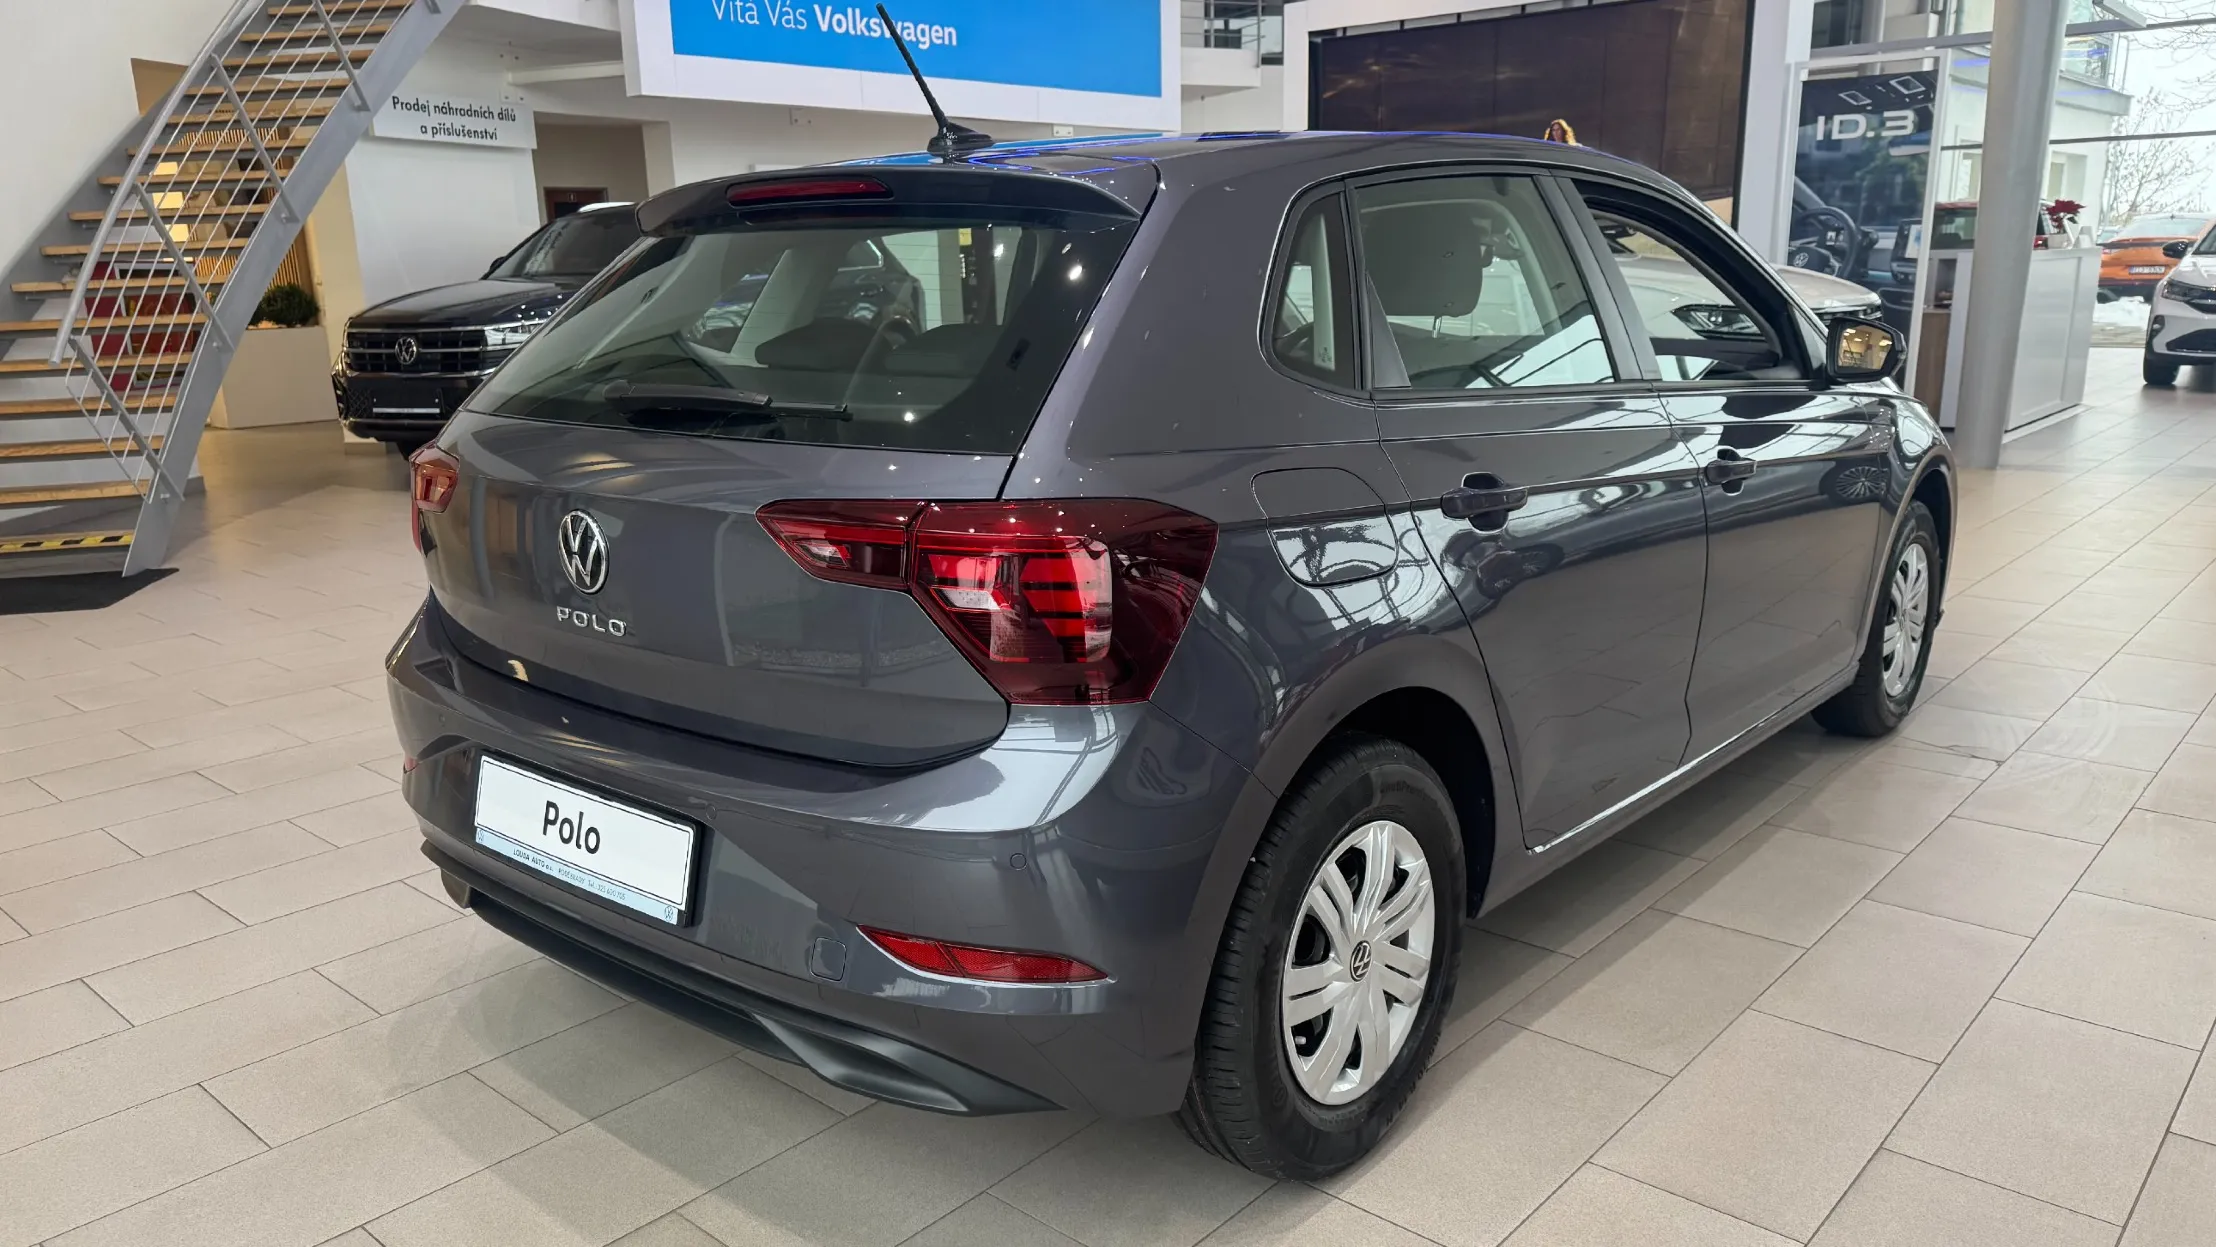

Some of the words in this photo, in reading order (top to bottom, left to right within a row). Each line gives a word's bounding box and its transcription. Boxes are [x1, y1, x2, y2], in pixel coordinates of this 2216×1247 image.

[764, 0, 808, 30] Vás
[391, 95, 431, 117] Prodej
[433, 100, 495, 121] náhradních
[497, 107, 516, 122] dílů
[420, 123, 428, 135] a
[431, 121, 498, 141] příslušenství
[1816, 109, 1916, 141] ID.3
[559, 508, 610, 595] VW
[556, 605, 628, 637] POLO
[542, 799, 601, 855] Polo
